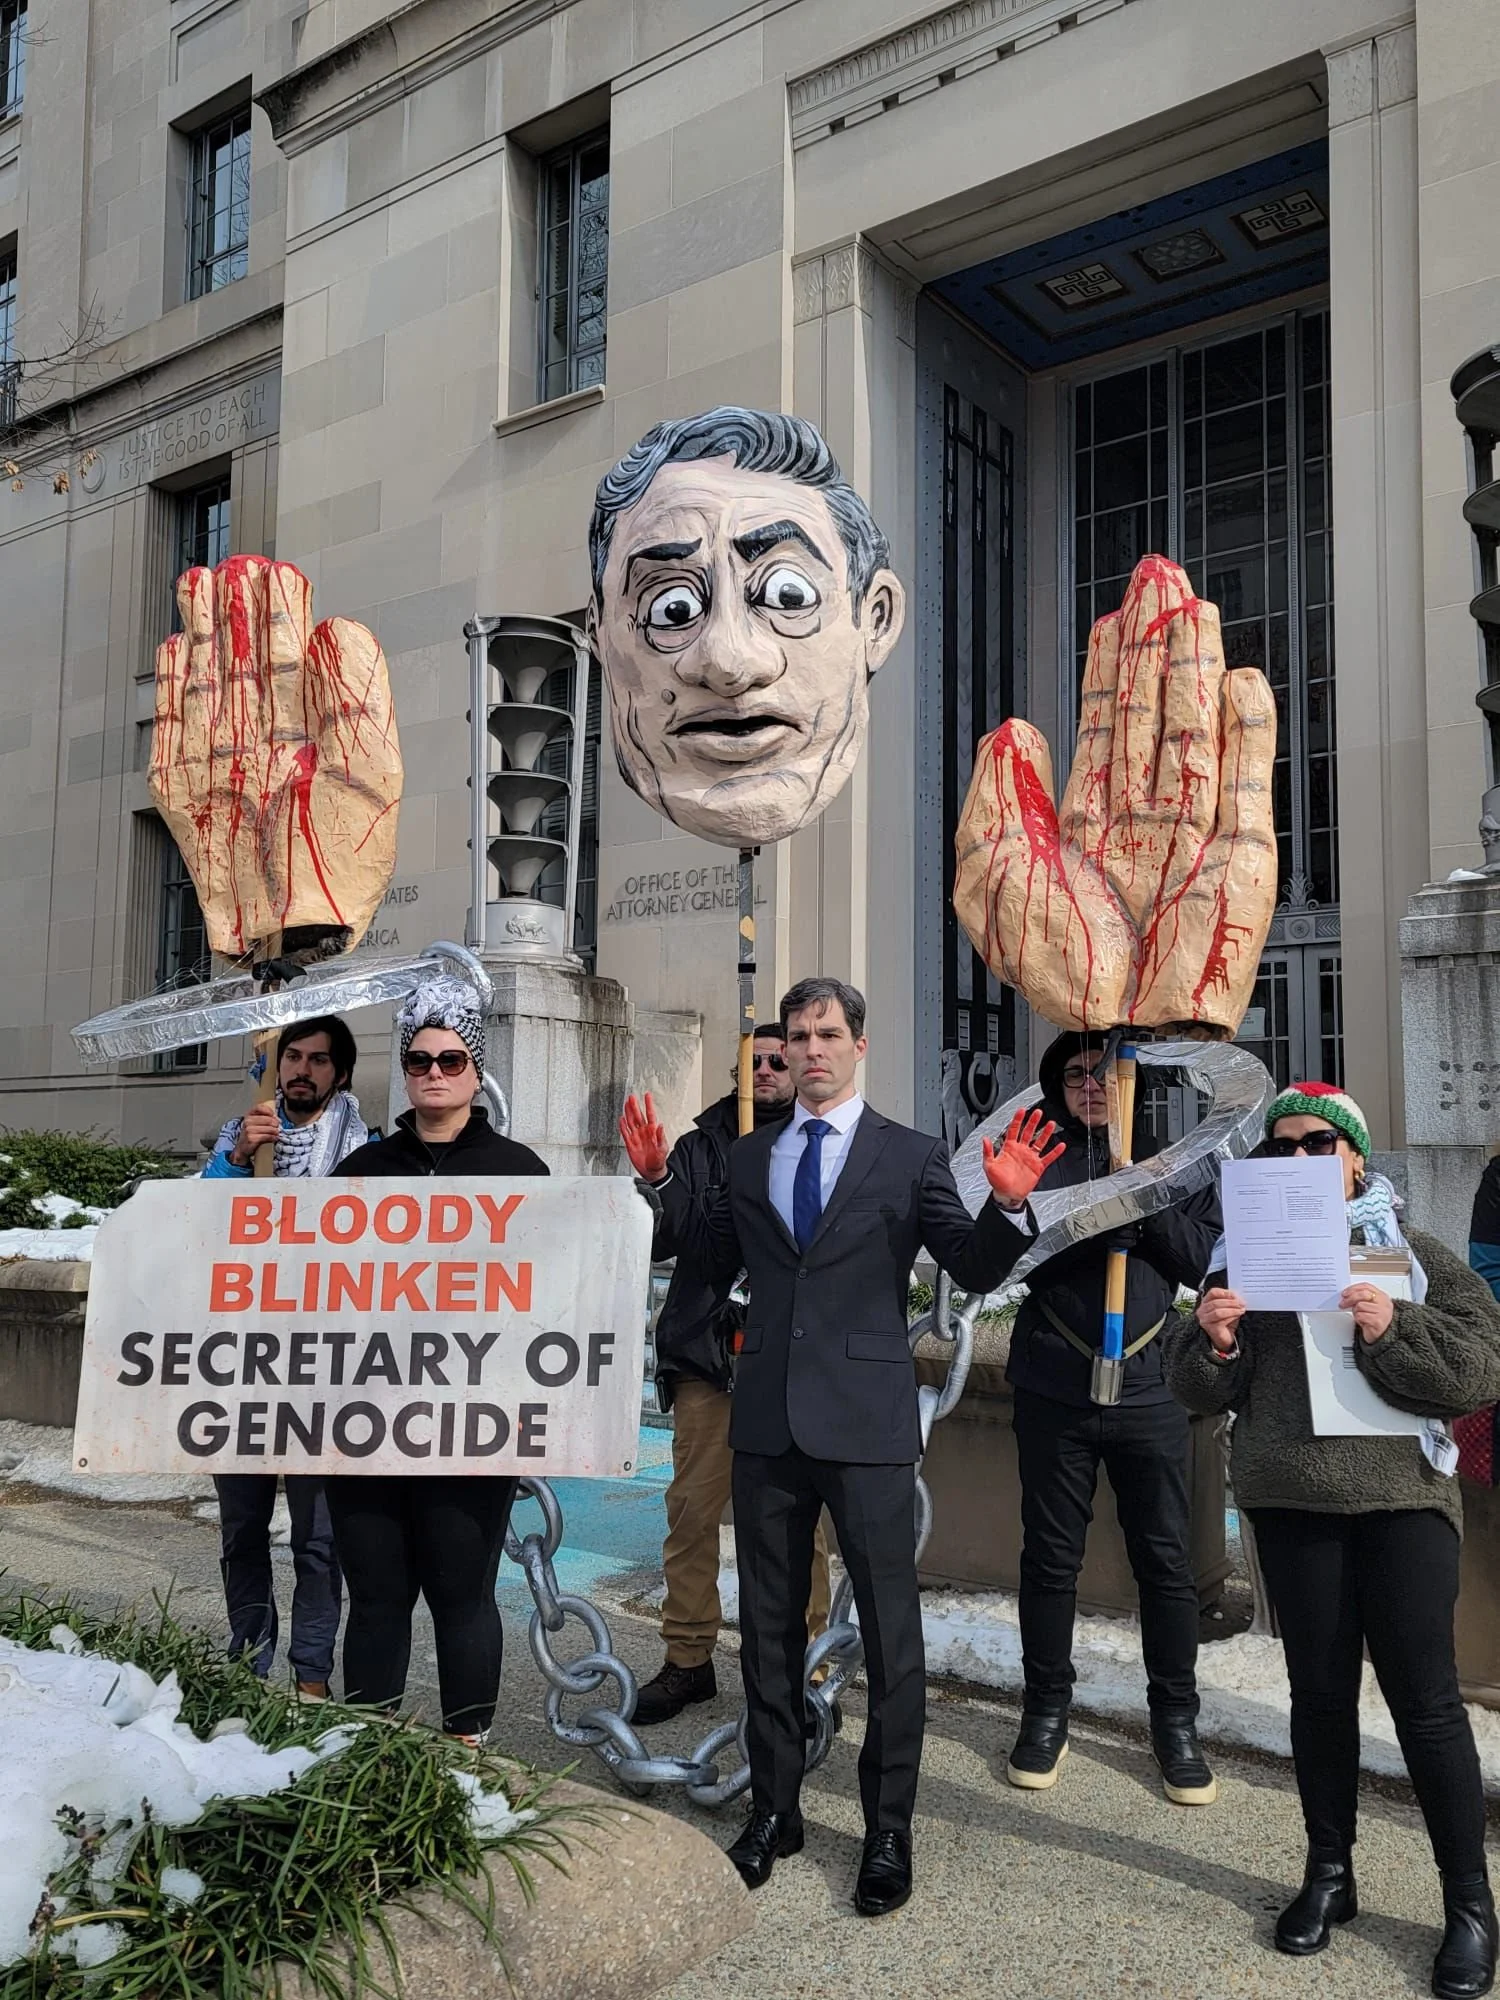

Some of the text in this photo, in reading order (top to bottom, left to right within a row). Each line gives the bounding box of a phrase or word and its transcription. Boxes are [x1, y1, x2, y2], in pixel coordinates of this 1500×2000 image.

[119, 407, 267, 480] IS THE GOOD OF ALL
[120, 383, 265, 462] JUSTICE TO EACH
[380, 885, 418, 905] TATES
[606, 893, 690, 921] ATTORNEY
[625, 871, 681, 895] OFFICE
[686, 868, 709, 888] OF
[229, 1194, 526, 1245] BLOODY
[209, 1261, 532, 1313] BLINKEN
[117, 1331, 616, 1388] SECRETARY OF
[177, 1400, 548, 1458] GENOCIDE
